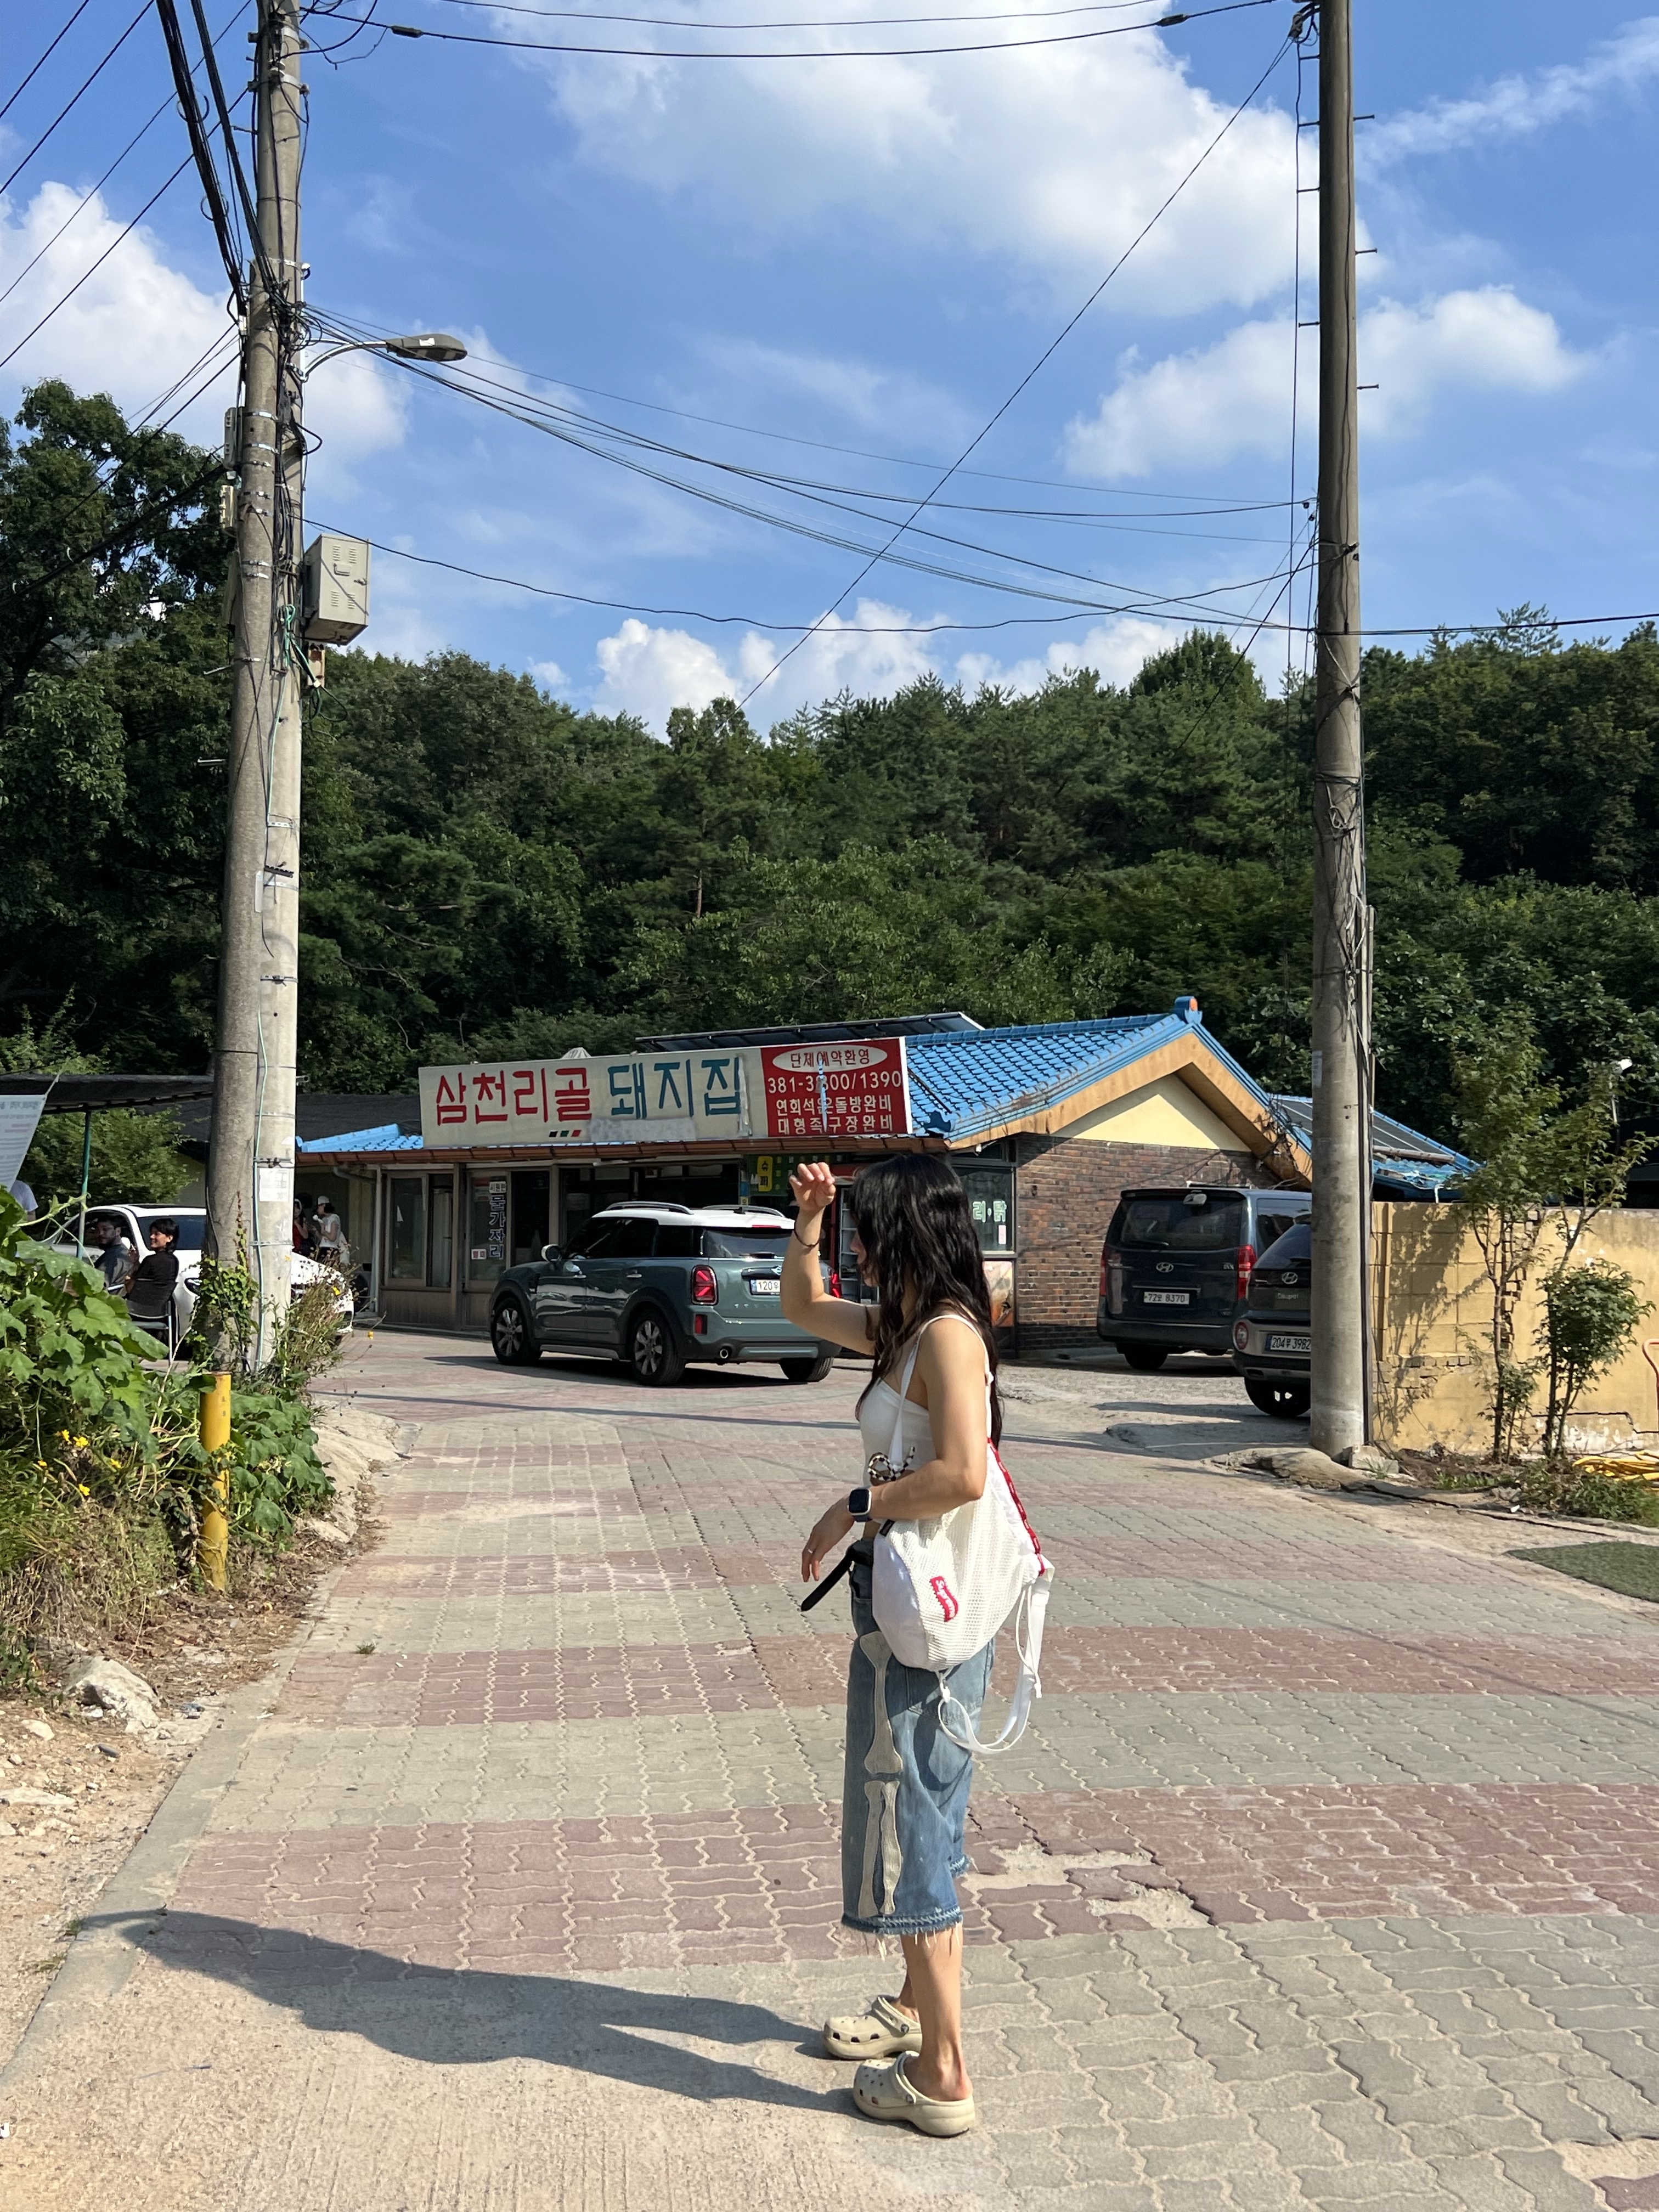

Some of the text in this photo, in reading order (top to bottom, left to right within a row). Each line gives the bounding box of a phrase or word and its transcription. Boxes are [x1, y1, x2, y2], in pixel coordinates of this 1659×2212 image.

[436, 1057, 741, 1126] 삼천리골 돼지집
[1165, 1294, 1186, 1303] 8370
[1292, 1338, 1312, 1350] 3982
